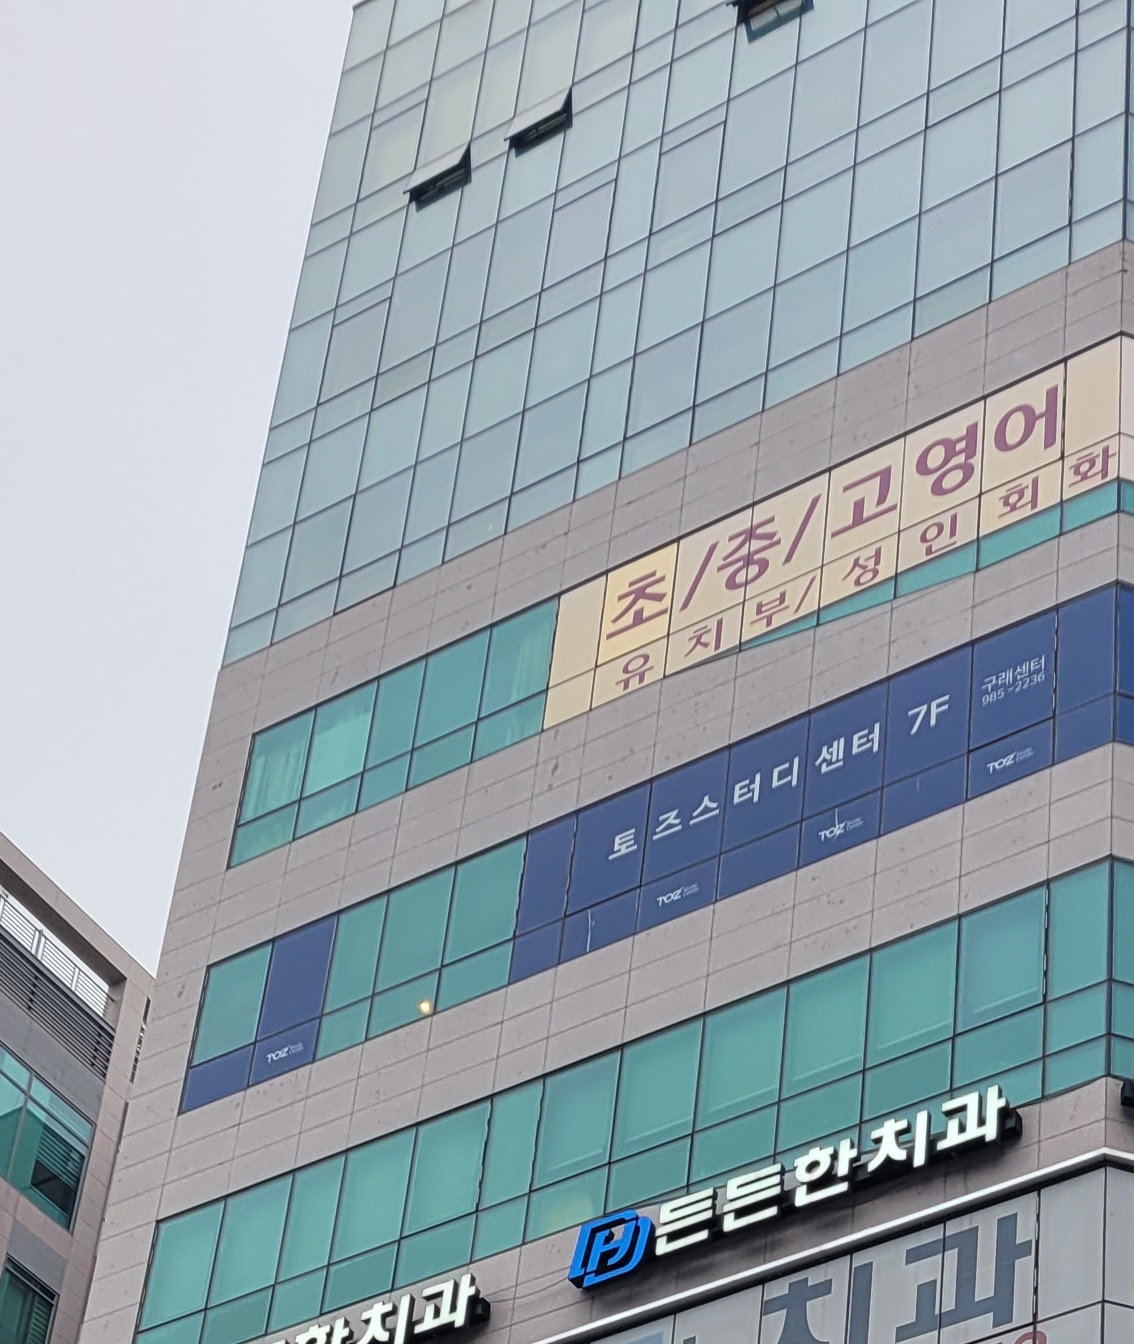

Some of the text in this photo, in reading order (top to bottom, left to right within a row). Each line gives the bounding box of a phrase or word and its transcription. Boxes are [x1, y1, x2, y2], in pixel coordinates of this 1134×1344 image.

[982, 654, 1047, 693] 구래센터
[907, 695, 951, 736] 7F
[987, 752, 1015, 774] TOZ
[656, 887, 683, 907] TOZ
[266, 1048, 290, 1064] TOZ
[655, 1085, 1008, 1257] 든든한치과
